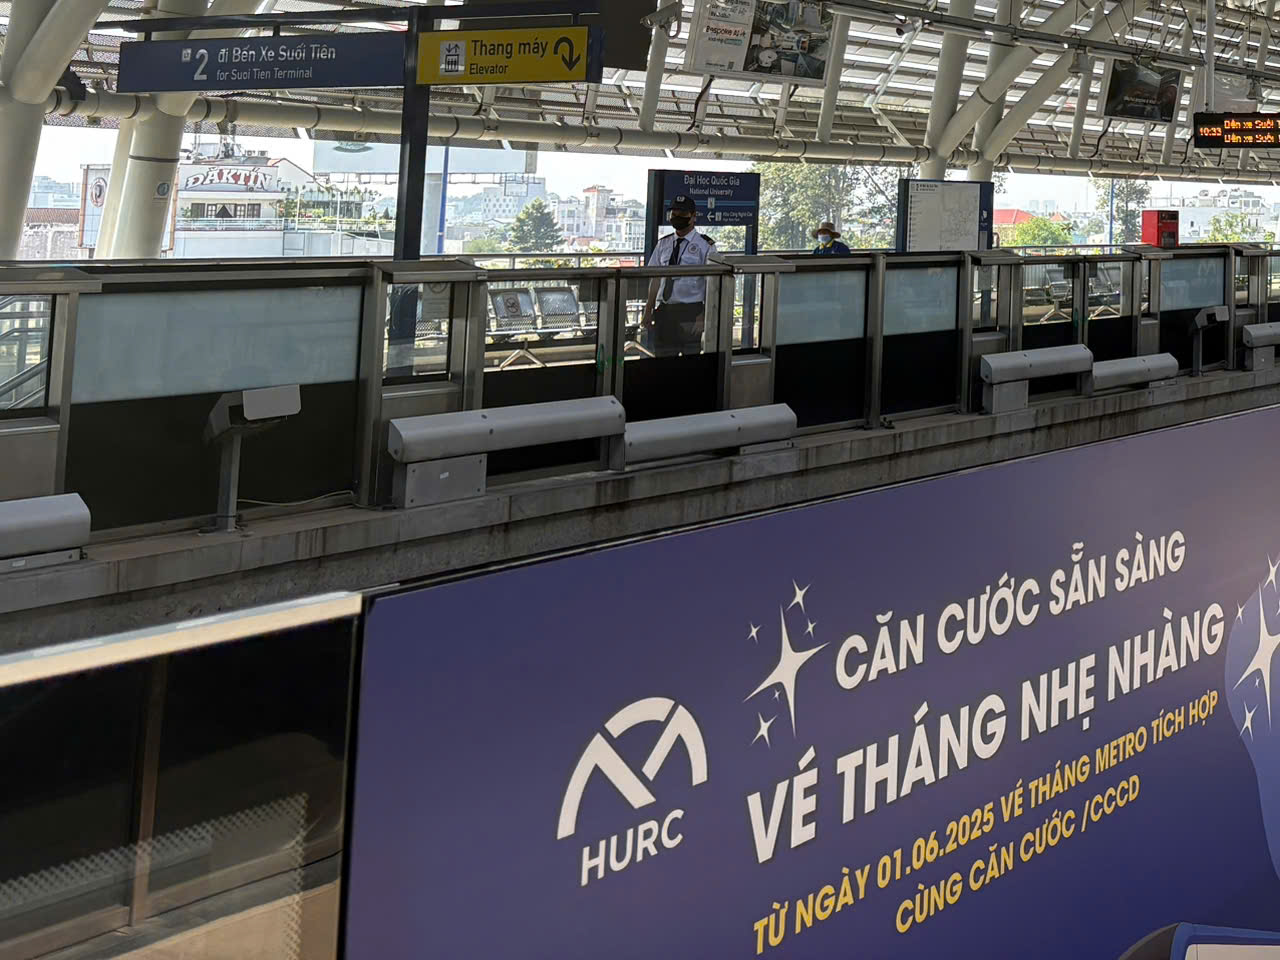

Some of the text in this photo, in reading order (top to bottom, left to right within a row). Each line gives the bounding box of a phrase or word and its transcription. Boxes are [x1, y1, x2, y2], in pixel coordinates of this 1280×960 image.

[217, 43, 336, 64] đi Bến Xe Suối Tiên
[471, 37, 549, 59] Thang máy
[193, 48, 209, 81] 2
[216, 67, 313, 81] for Suoi Tien Terminal
[469, 63, 509, 76] Elevator
[1199, 127, 1222, 137] 10:33
[729, 175, 740, 186] Gia
[710, 188, 734, 197] University
[835, 530, 1186, 690] CĂN CƯỚC SẴN SÀNG
[747, 602, 1225, 864] VÉ THÁNG NHẸ NHÀNG
[753, 689, 1218, 955] TỪ NGÀY 01.06.2025 VÉ THÁNG METRO TÍCH HỢP
[580, 808, 685, 887] HURC
[895, 774, 1141, 934] CÙNG CĂN CƯỚC /CCCD
